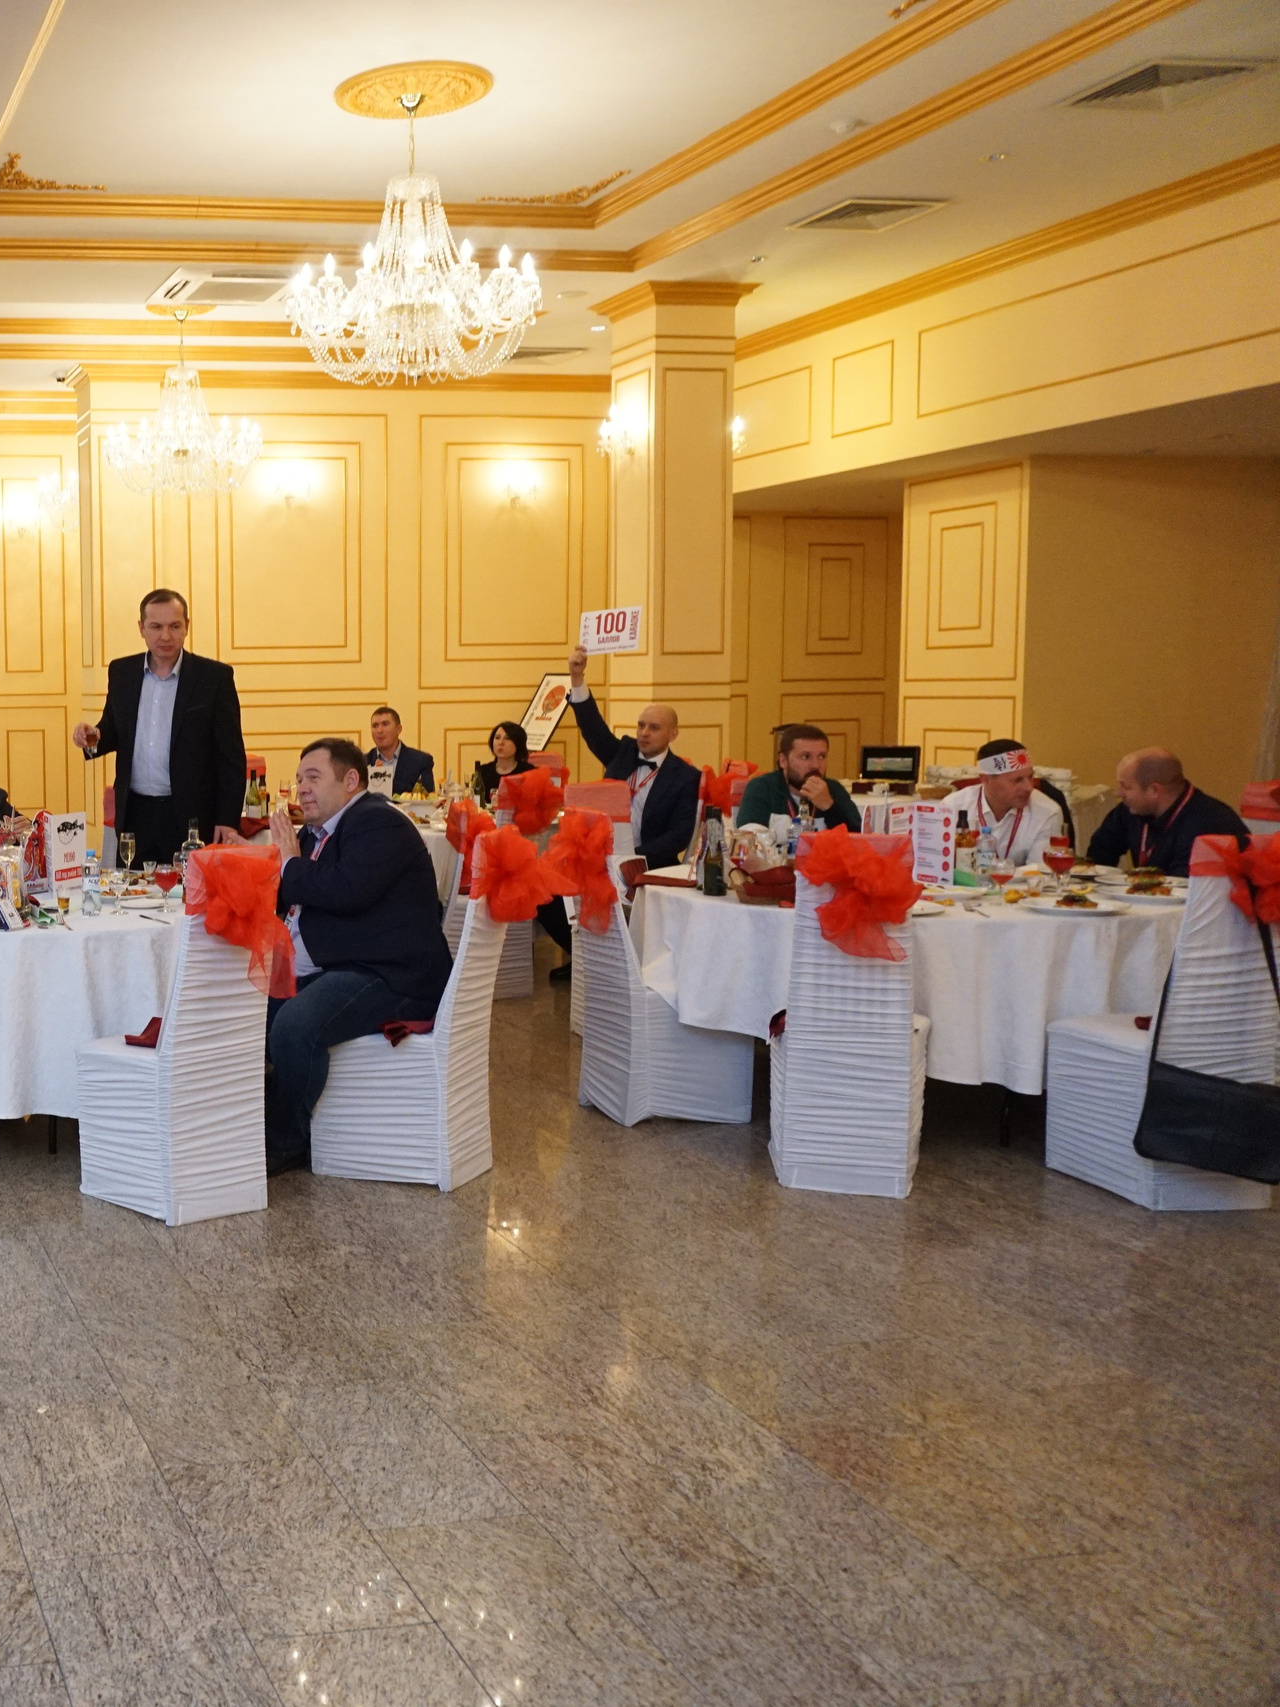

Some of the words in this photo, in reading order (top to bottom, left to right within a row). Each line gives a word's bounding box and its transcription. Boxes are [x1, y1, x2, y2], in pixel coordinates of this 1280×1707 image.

[595, 610, 627, 635] 100
[629, 609, 640, 641] KARAOKE
[597, 635, 621, 645] БАЛЛОВ
